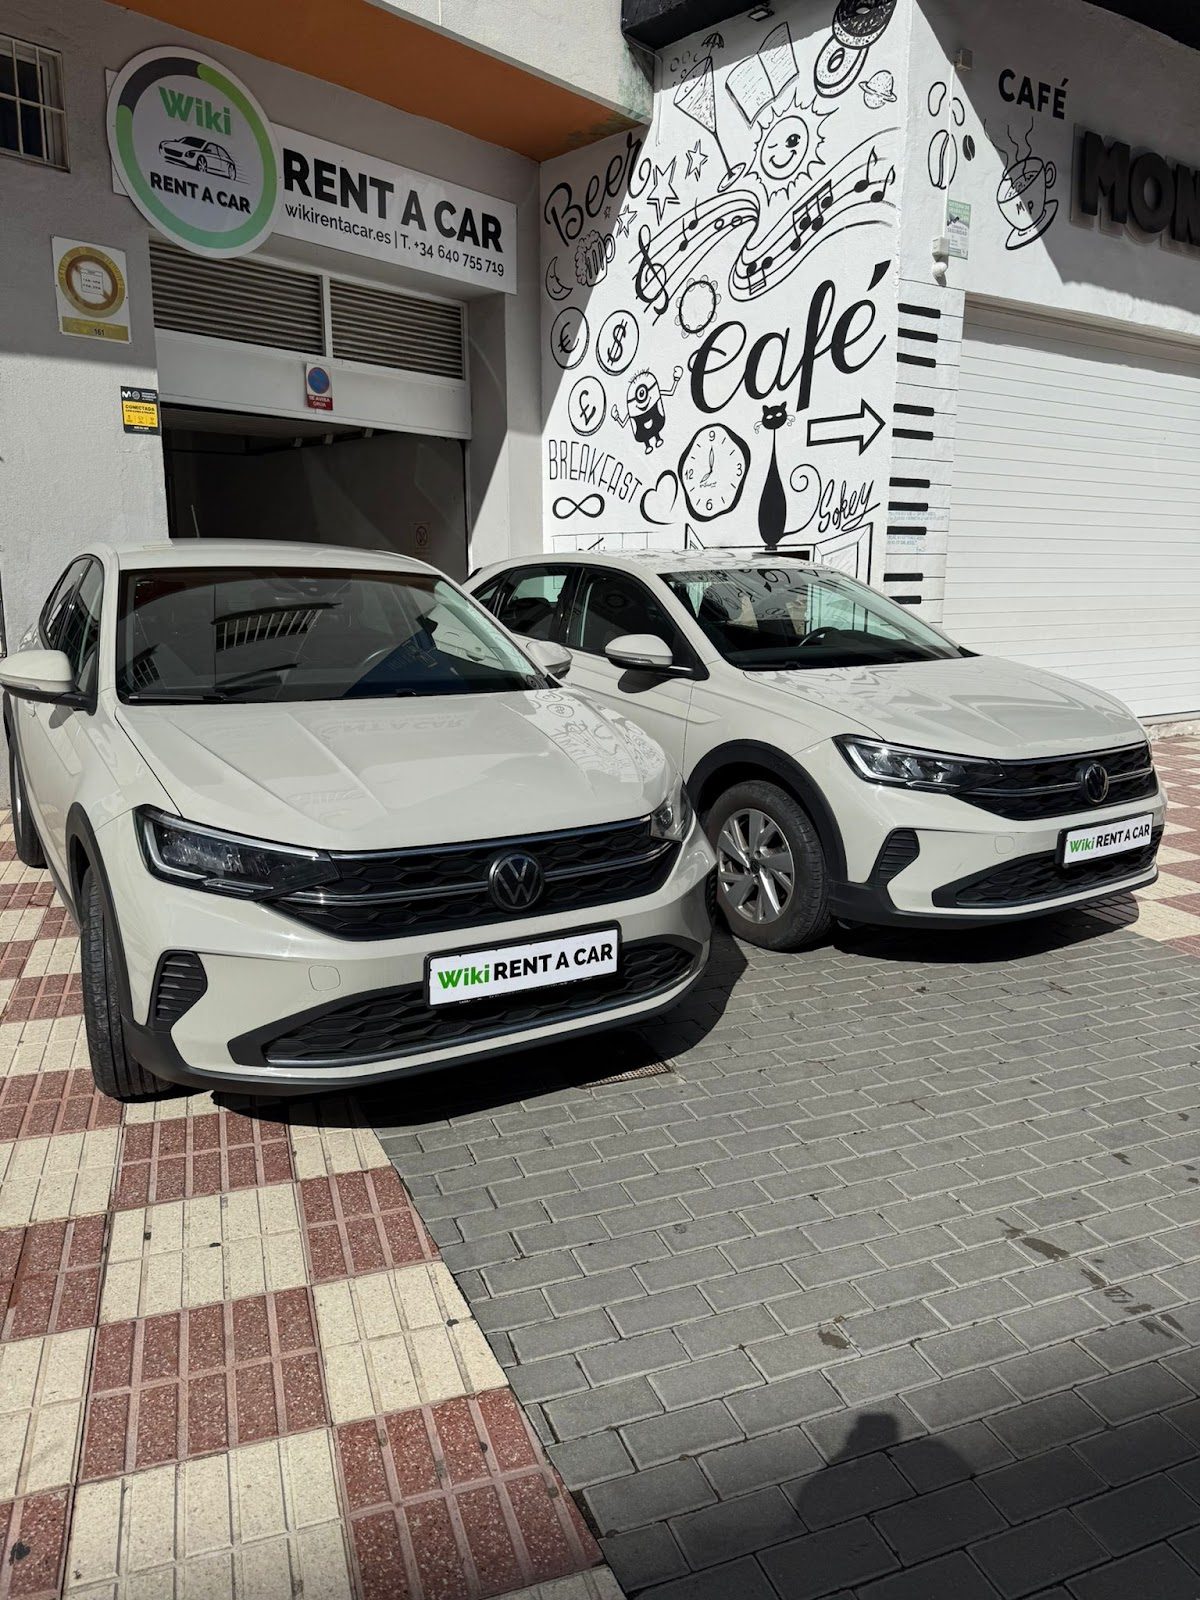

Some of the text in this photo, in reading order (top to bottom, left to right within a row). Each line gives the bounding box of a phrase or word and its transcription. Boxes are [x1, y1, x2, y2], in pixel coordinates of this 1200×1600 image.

[158, 85, 231, 136] Wiki
[998, 69, 1068, 120] CAFÉ
[150, 171, 251, 214] RENT A CAR
[283, 148, 504, 253] RENT A CAR
[545, 132, 652, 247] Beer
[285, 204, 391, 244] wikirentacar.es
[401, 234, 411, 250] T.
[414, 241, 434, 258] +34
[438, 245, 459, 263] 640
[463, 253, 482, 271] 755
[485, 260, 504, 277] 719
[688, 260, 886, 413] Café
[125, 404, 155, 412] CONECTADA
[709, 430, 715, 441] 9
[548, 439, 644, 505] BREAKFAST
[684, 468, 694, 480] 12
[736, 463, 742, 476] 3
[706, 498, 713, 511] 6
[1070, 824, 1150, 853] Wiki RENT A CAR
[438, 943, 613, 989] Wiki RENT A CAR
